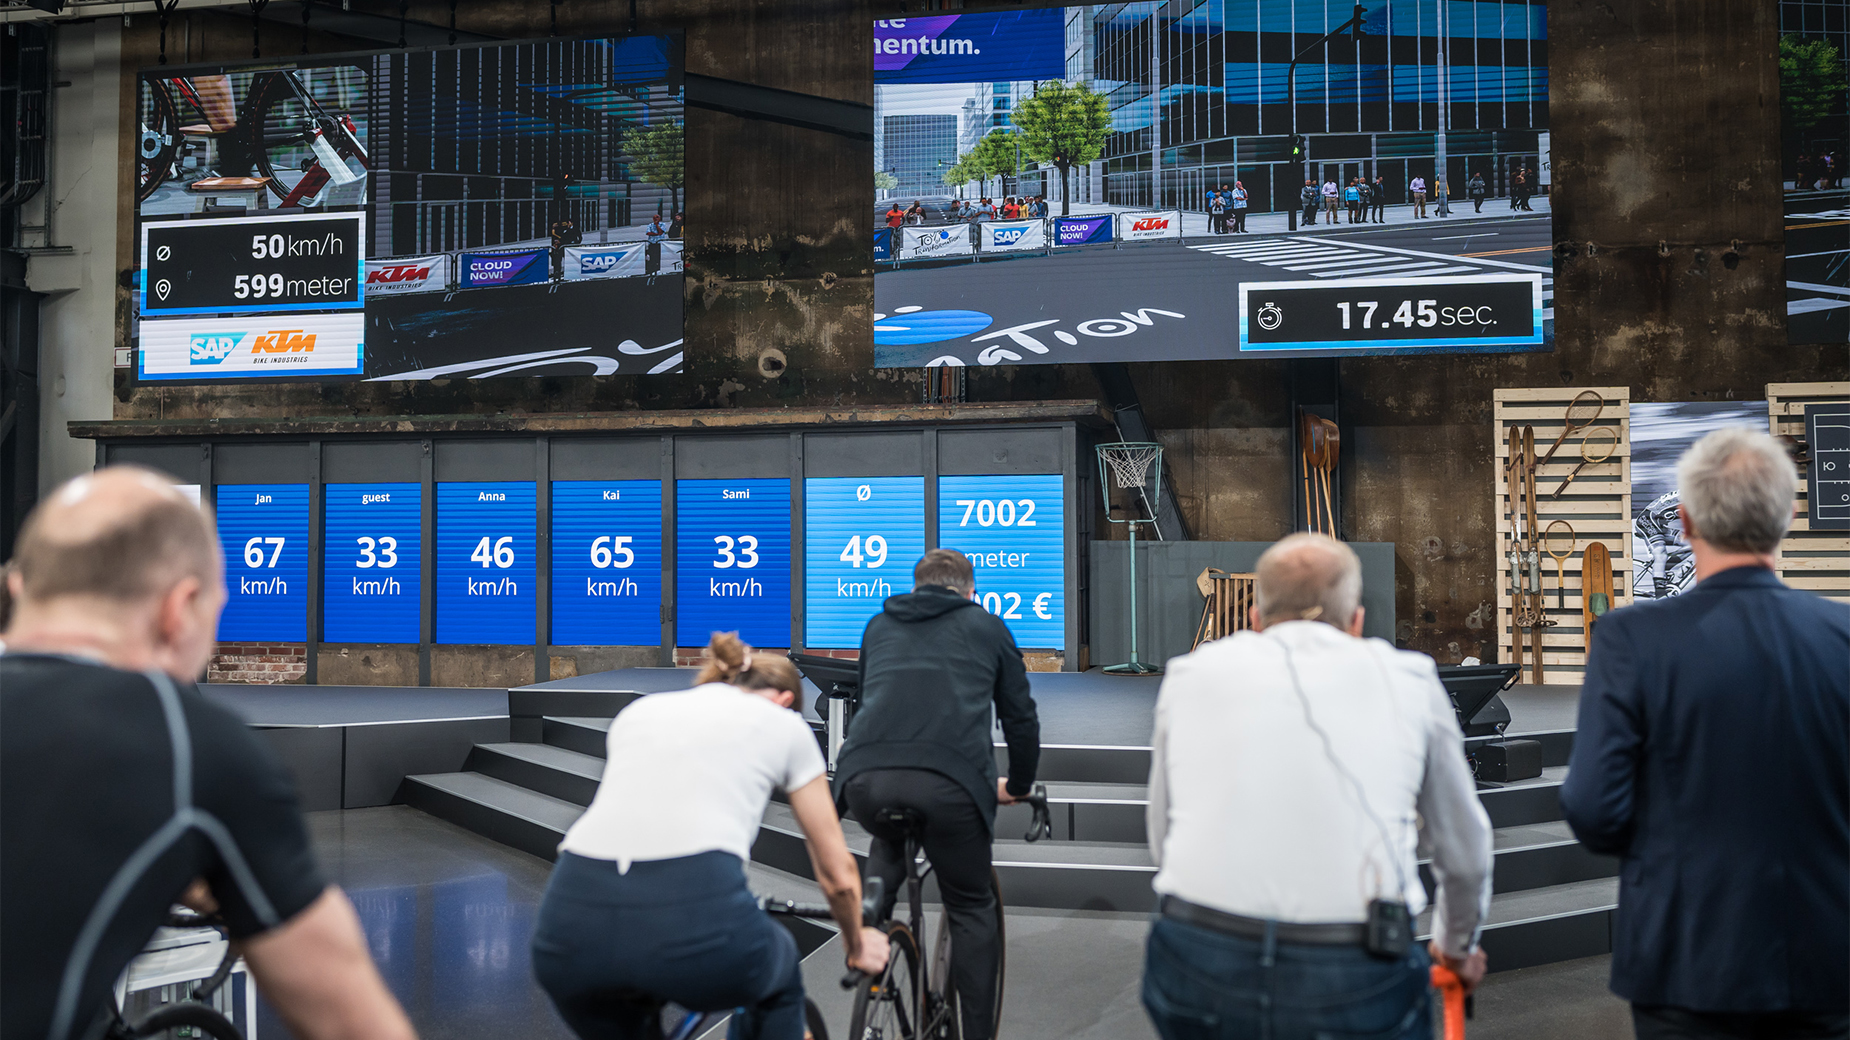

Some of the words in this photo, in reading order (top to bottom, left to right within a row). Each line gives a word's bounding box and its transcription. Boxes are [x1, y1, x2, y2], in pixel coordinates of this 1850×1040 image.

[1060, 223, 1088, 232] CLOUD
[1132, 217, 1169, 231] KTM
[994, 231, 1022, 243] SAP
[1060, 232, 1083, 240] NOW!
[470, 260, 512, 271] CLOUD
[581, 255, 617, 271] SAP
[365, 264, 430, 284] KTM
[470, 271, 503, 281] NOW!
[190, 337, 234, 361] SAP
[251, 329, 317, 354] KTM
[270, 356, 308, 364] INDUSTRIES
[255, 493, 272, 506] Jan
[362, 493, 391, 505] guest
[478, 491, 506, 502] Anna
[603, 490, 620, 501] Kai
[722, 489, 750, 500] Sami
[956, 499, 1037, 527] 7002
[244, 536, 286, 569] 67
[356, 536, 398, 569] 33
[470, 536, 515, 569] 46
[590, 536, 635, 569] 65
[713, 535, 759, 569] 33
[839, 535, 888, 569] 49
[964, 550, 1030, 568] meter
[241, 577, 287, 596] km/h
[352, 577, 400, 596] km/h
[468, 577, 517, 597] km/h
[587, 577, 637, 598] km/h
[710, 577, 762, 598] km/h
[837, 577, 891, 598] km/h
[1032, 592, 1052, 620] €
